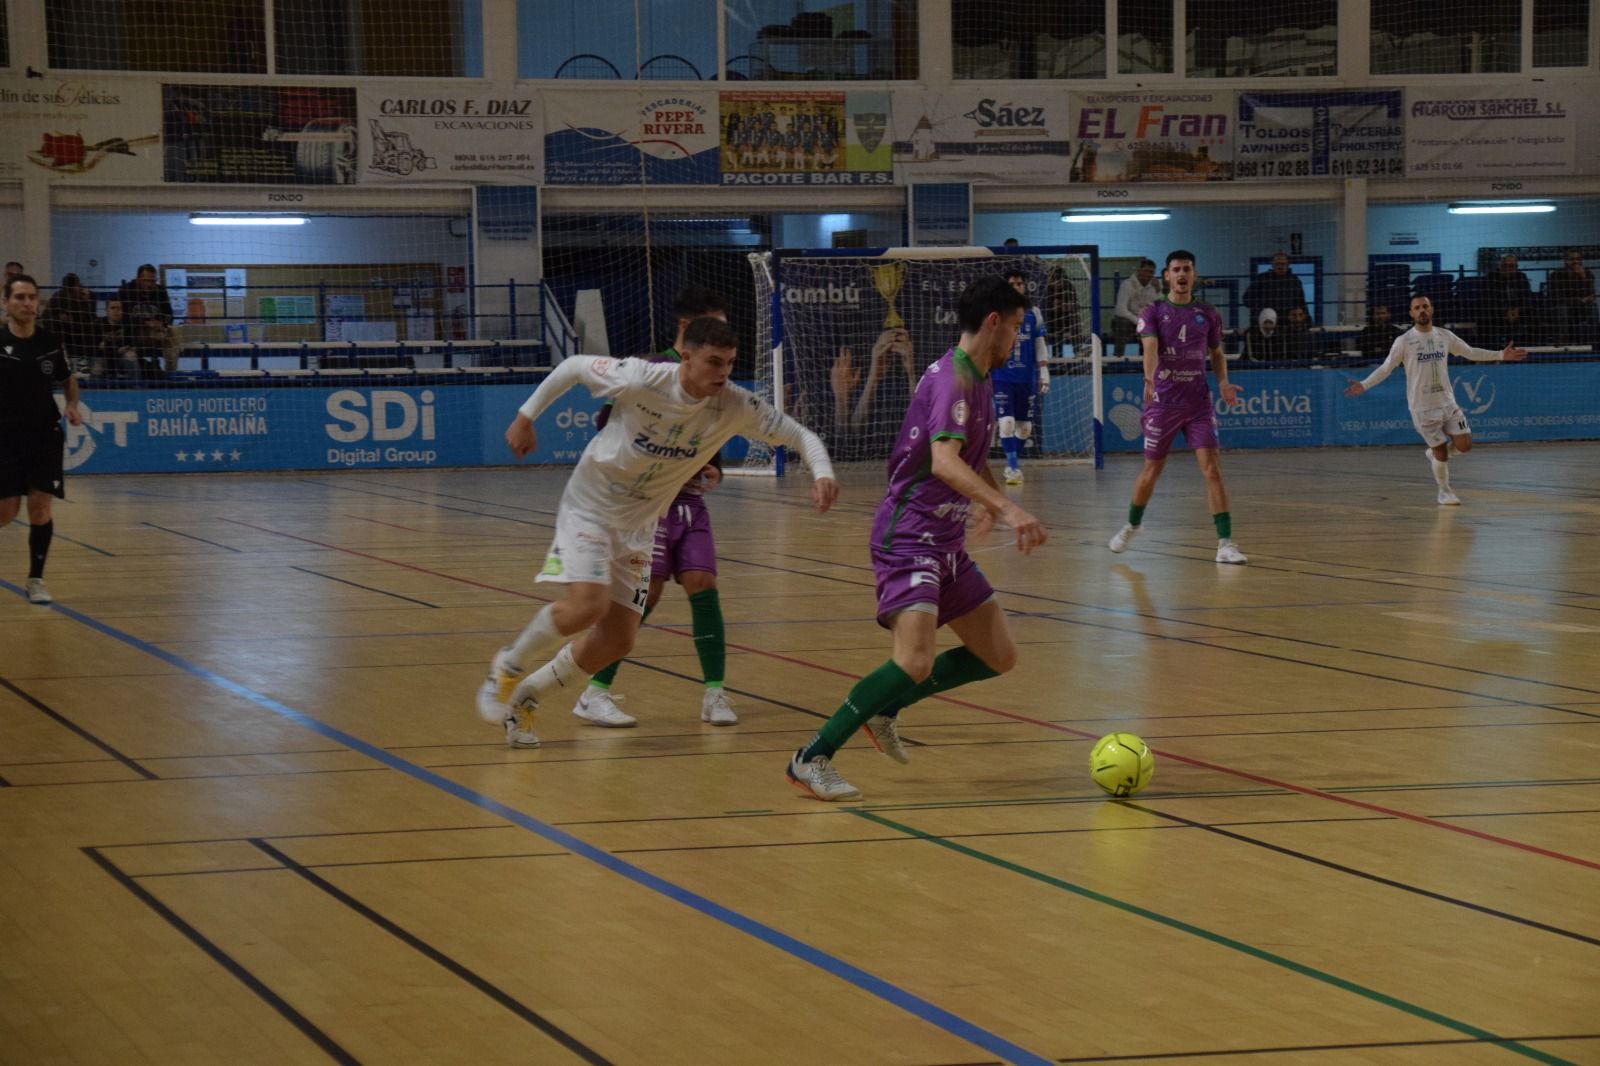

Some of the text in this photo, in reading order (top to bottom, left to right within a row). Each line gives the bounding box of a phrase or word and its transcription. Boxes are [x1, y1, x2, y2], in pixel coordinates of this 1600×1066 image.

[22, 90, 40, 103] de
[43, 93, 65, 104] sus
[1086, 94, 1213, 104] TRANSPORTES Y EXCAVACIONES
[380, 99, 457, 115] CARLOS
[463, 100, 480, 115] F.
[639, 98, 707, 116] PESCADERIAS
[977, 98, 1046, 127] Sáez
[655, 111, 695, 123] PEPE
[1077, 105, 1228, 139] EL Fran
[434, 120, 534, 131] EXCAVACIONES
[643, 124, 705, 135] RIVERA
[1240, 124, 1311, 139] TOLDOS
[1240, 142, 1402, 154] AWNINGS UPHOLSTERY
[1237, 160, 1257, 176] 968
[1261, 161, 1275, 175] 17
[1278, 161, 1292, 175] 92
[1356, 160, 1370, 173] 52
[1373, 159, 1386, 173] 34
[722, 172, 893, 185] PACOTE BAR F.S.
[1097, 189, 1129, 199] FONDO
[1491, 182, 1523, 192] FONDO
[268, 193, 304, 203] FONDO
[922, 281, 940, 291] EL
[1177, 323, 1188, 343] 4
[146, 397, 267, 415] GRUPO HOTELERO
[1210, 389, 1313, 416] oactiva
[324, 390, 436, 443] SDi
[636, 402, 663, 419] KELME
[146, 414, 269, 437] BAHÍA-TRAÍÑA
[1216, 418, 1242, 427] NICA
[1471, 416, 1520, 428] CLUSIVAS
[1523, 415, 1573, 426] BODEGAS
[1271, 429, 1313, 438] MURCIA
[327, 448, 437, 466] Digital Group
